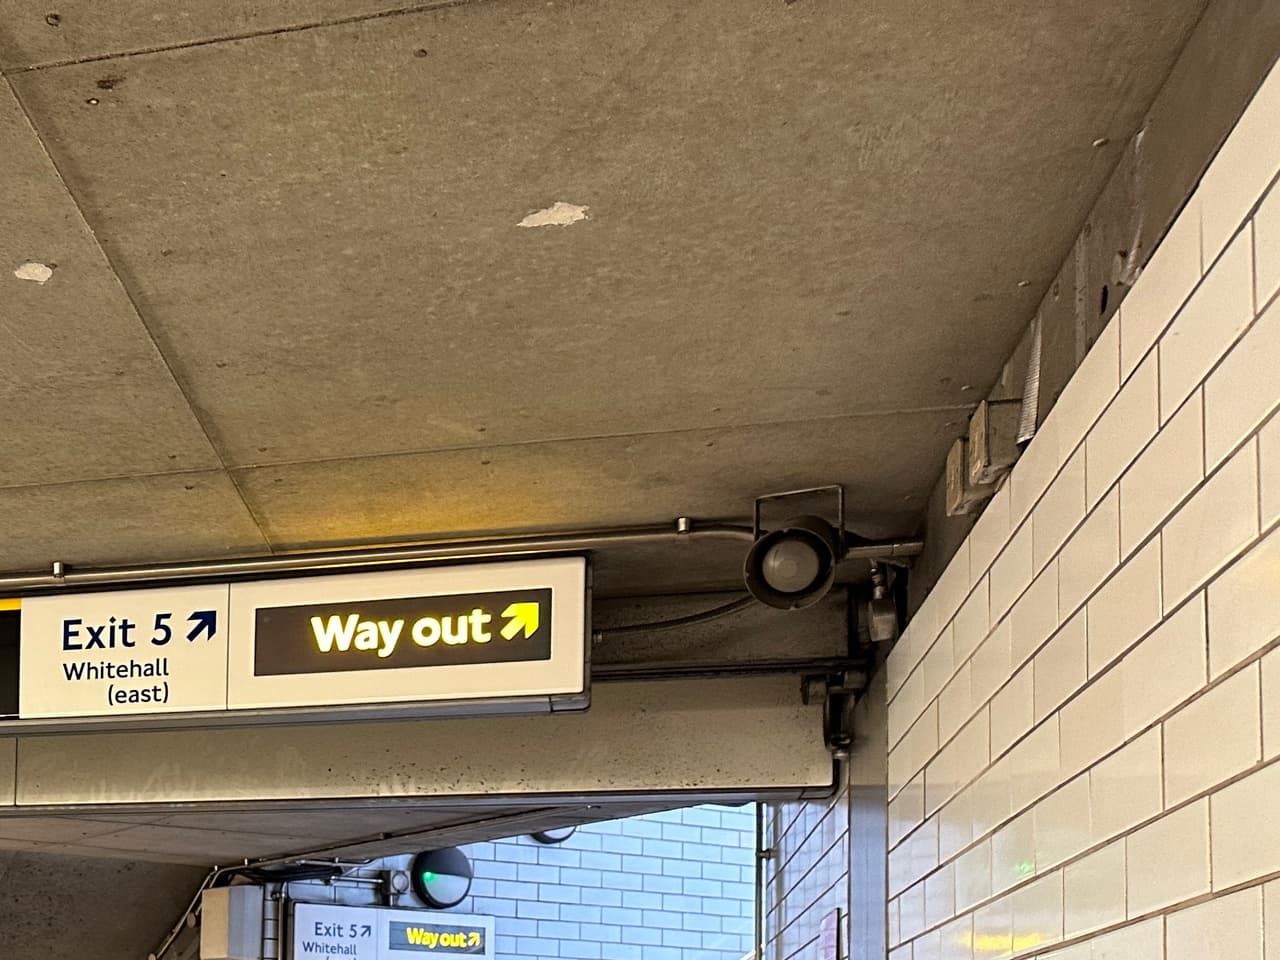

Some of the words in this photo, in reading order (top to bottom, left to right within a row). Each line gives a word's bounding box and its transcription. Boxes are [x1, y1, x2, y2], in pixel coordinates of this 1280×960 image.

[62, 615, 136, 651] Exit
[150, 612, 173, 647] 5
[310, 613, 404, 659] Way
[412, 607, 493, 648] out
[62, 658, 170, 682] Whitehall
[106, 681, 170, 707] (east)
[314, 921, 344, 938] Exit
[349, 923, 357, 938] 5
[406, 927, 439, 949] Way
[439, 932, 467, 948] out
[302, 941, 357, 956] Whitehall
